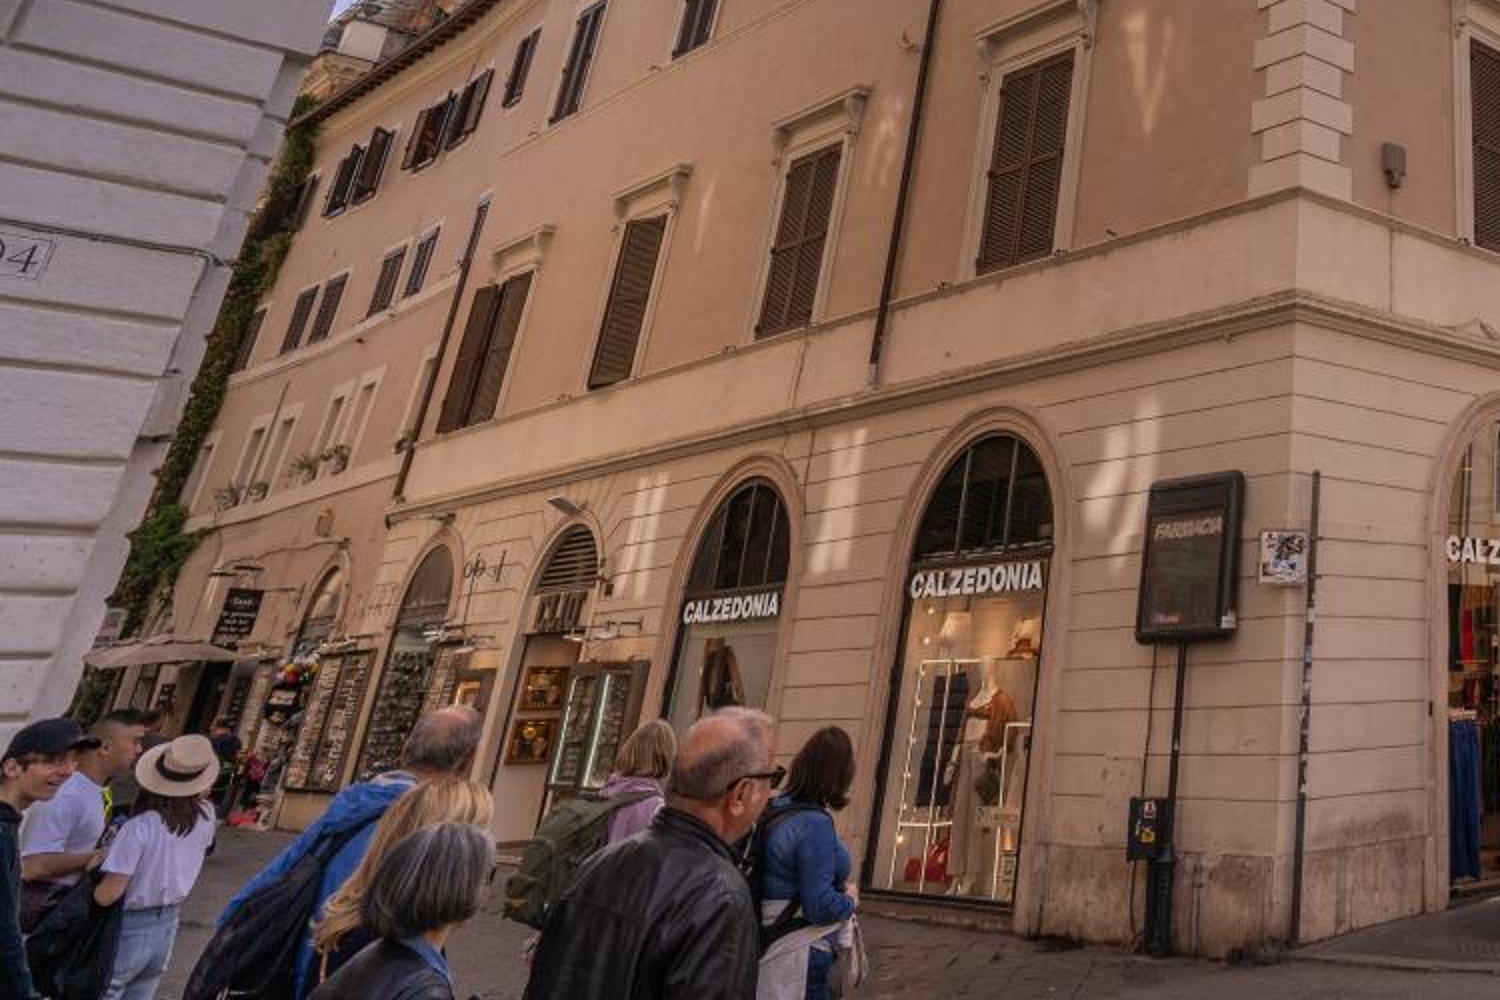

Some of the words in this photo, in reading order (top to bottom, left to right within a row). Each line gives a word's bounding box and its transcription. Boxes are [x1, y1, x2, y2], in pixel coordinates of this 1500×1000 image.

[0, 238, 38, 273] 4
[910, 561, 1043, 599] CALZEDONIA
[683, 591, 779, 624] CALZEDONIA
